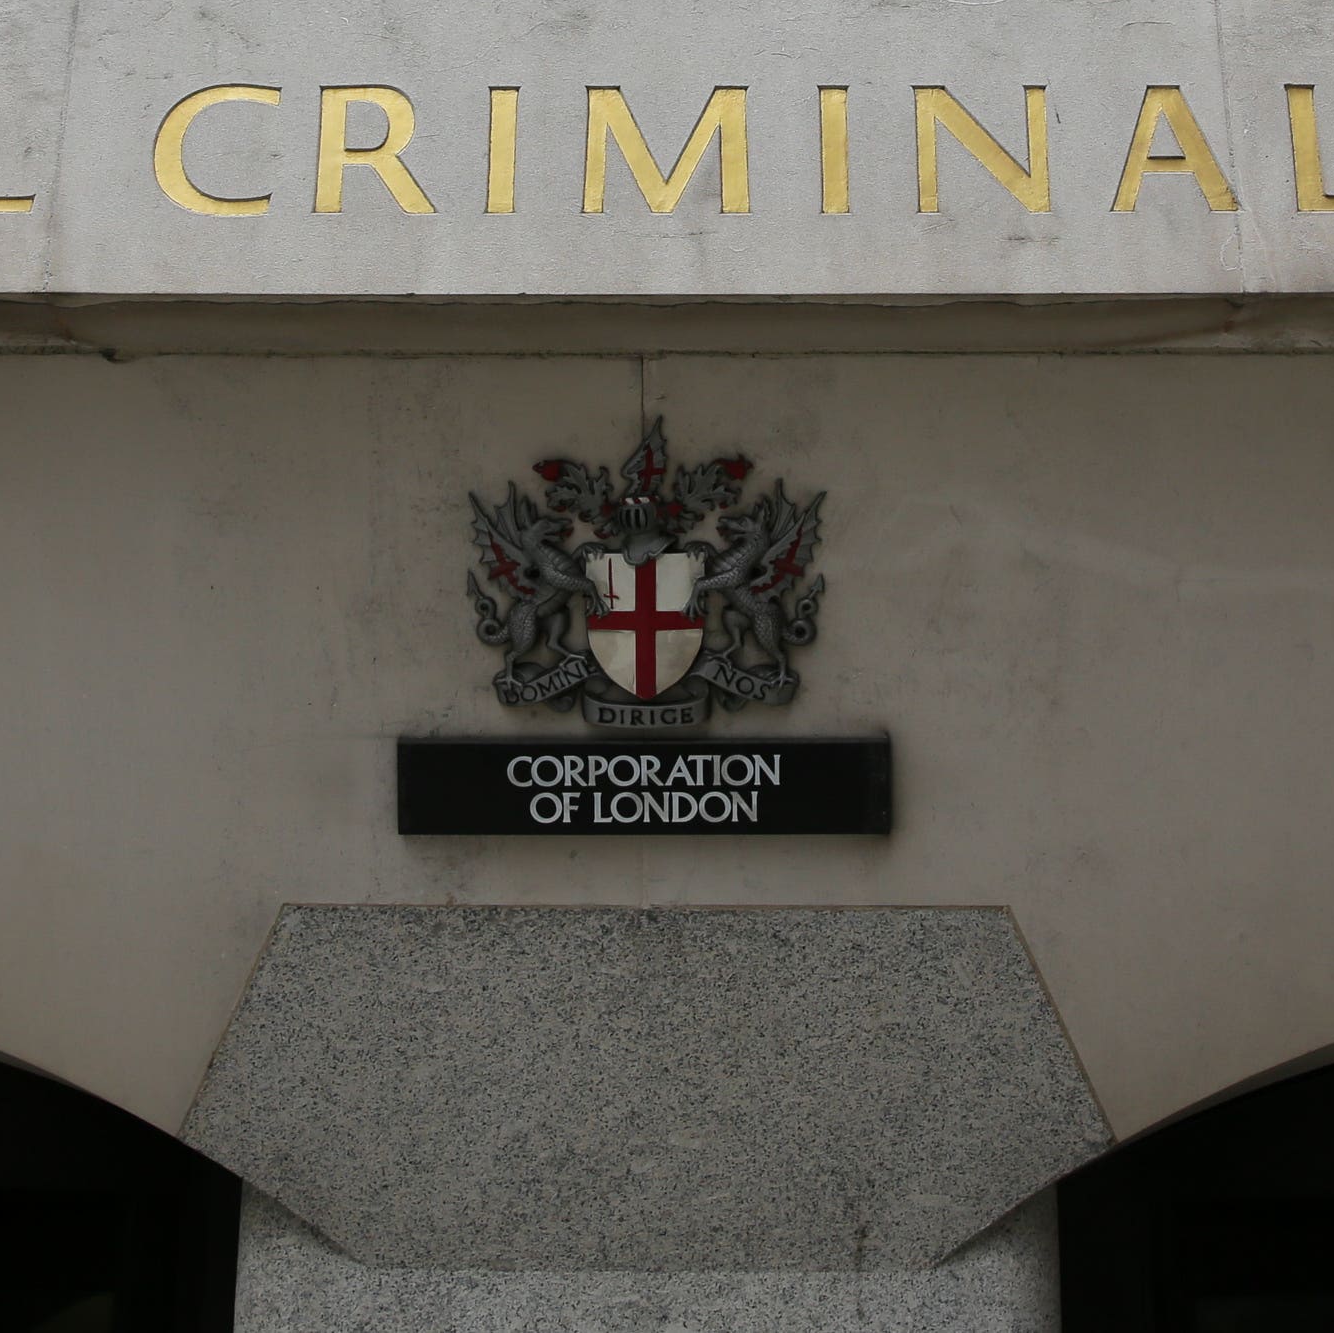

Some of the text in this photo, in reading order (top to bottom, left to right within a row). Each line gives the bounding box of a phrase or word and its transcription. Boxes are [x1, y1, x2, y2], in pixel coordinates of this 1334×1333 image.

[598, 706, 695, 725] DIRIGE
[713, 665, 771, 700] NOS
[507, 754, 781, 787] CORPORATION
[529, 791, 758, 823] OF LONDON
